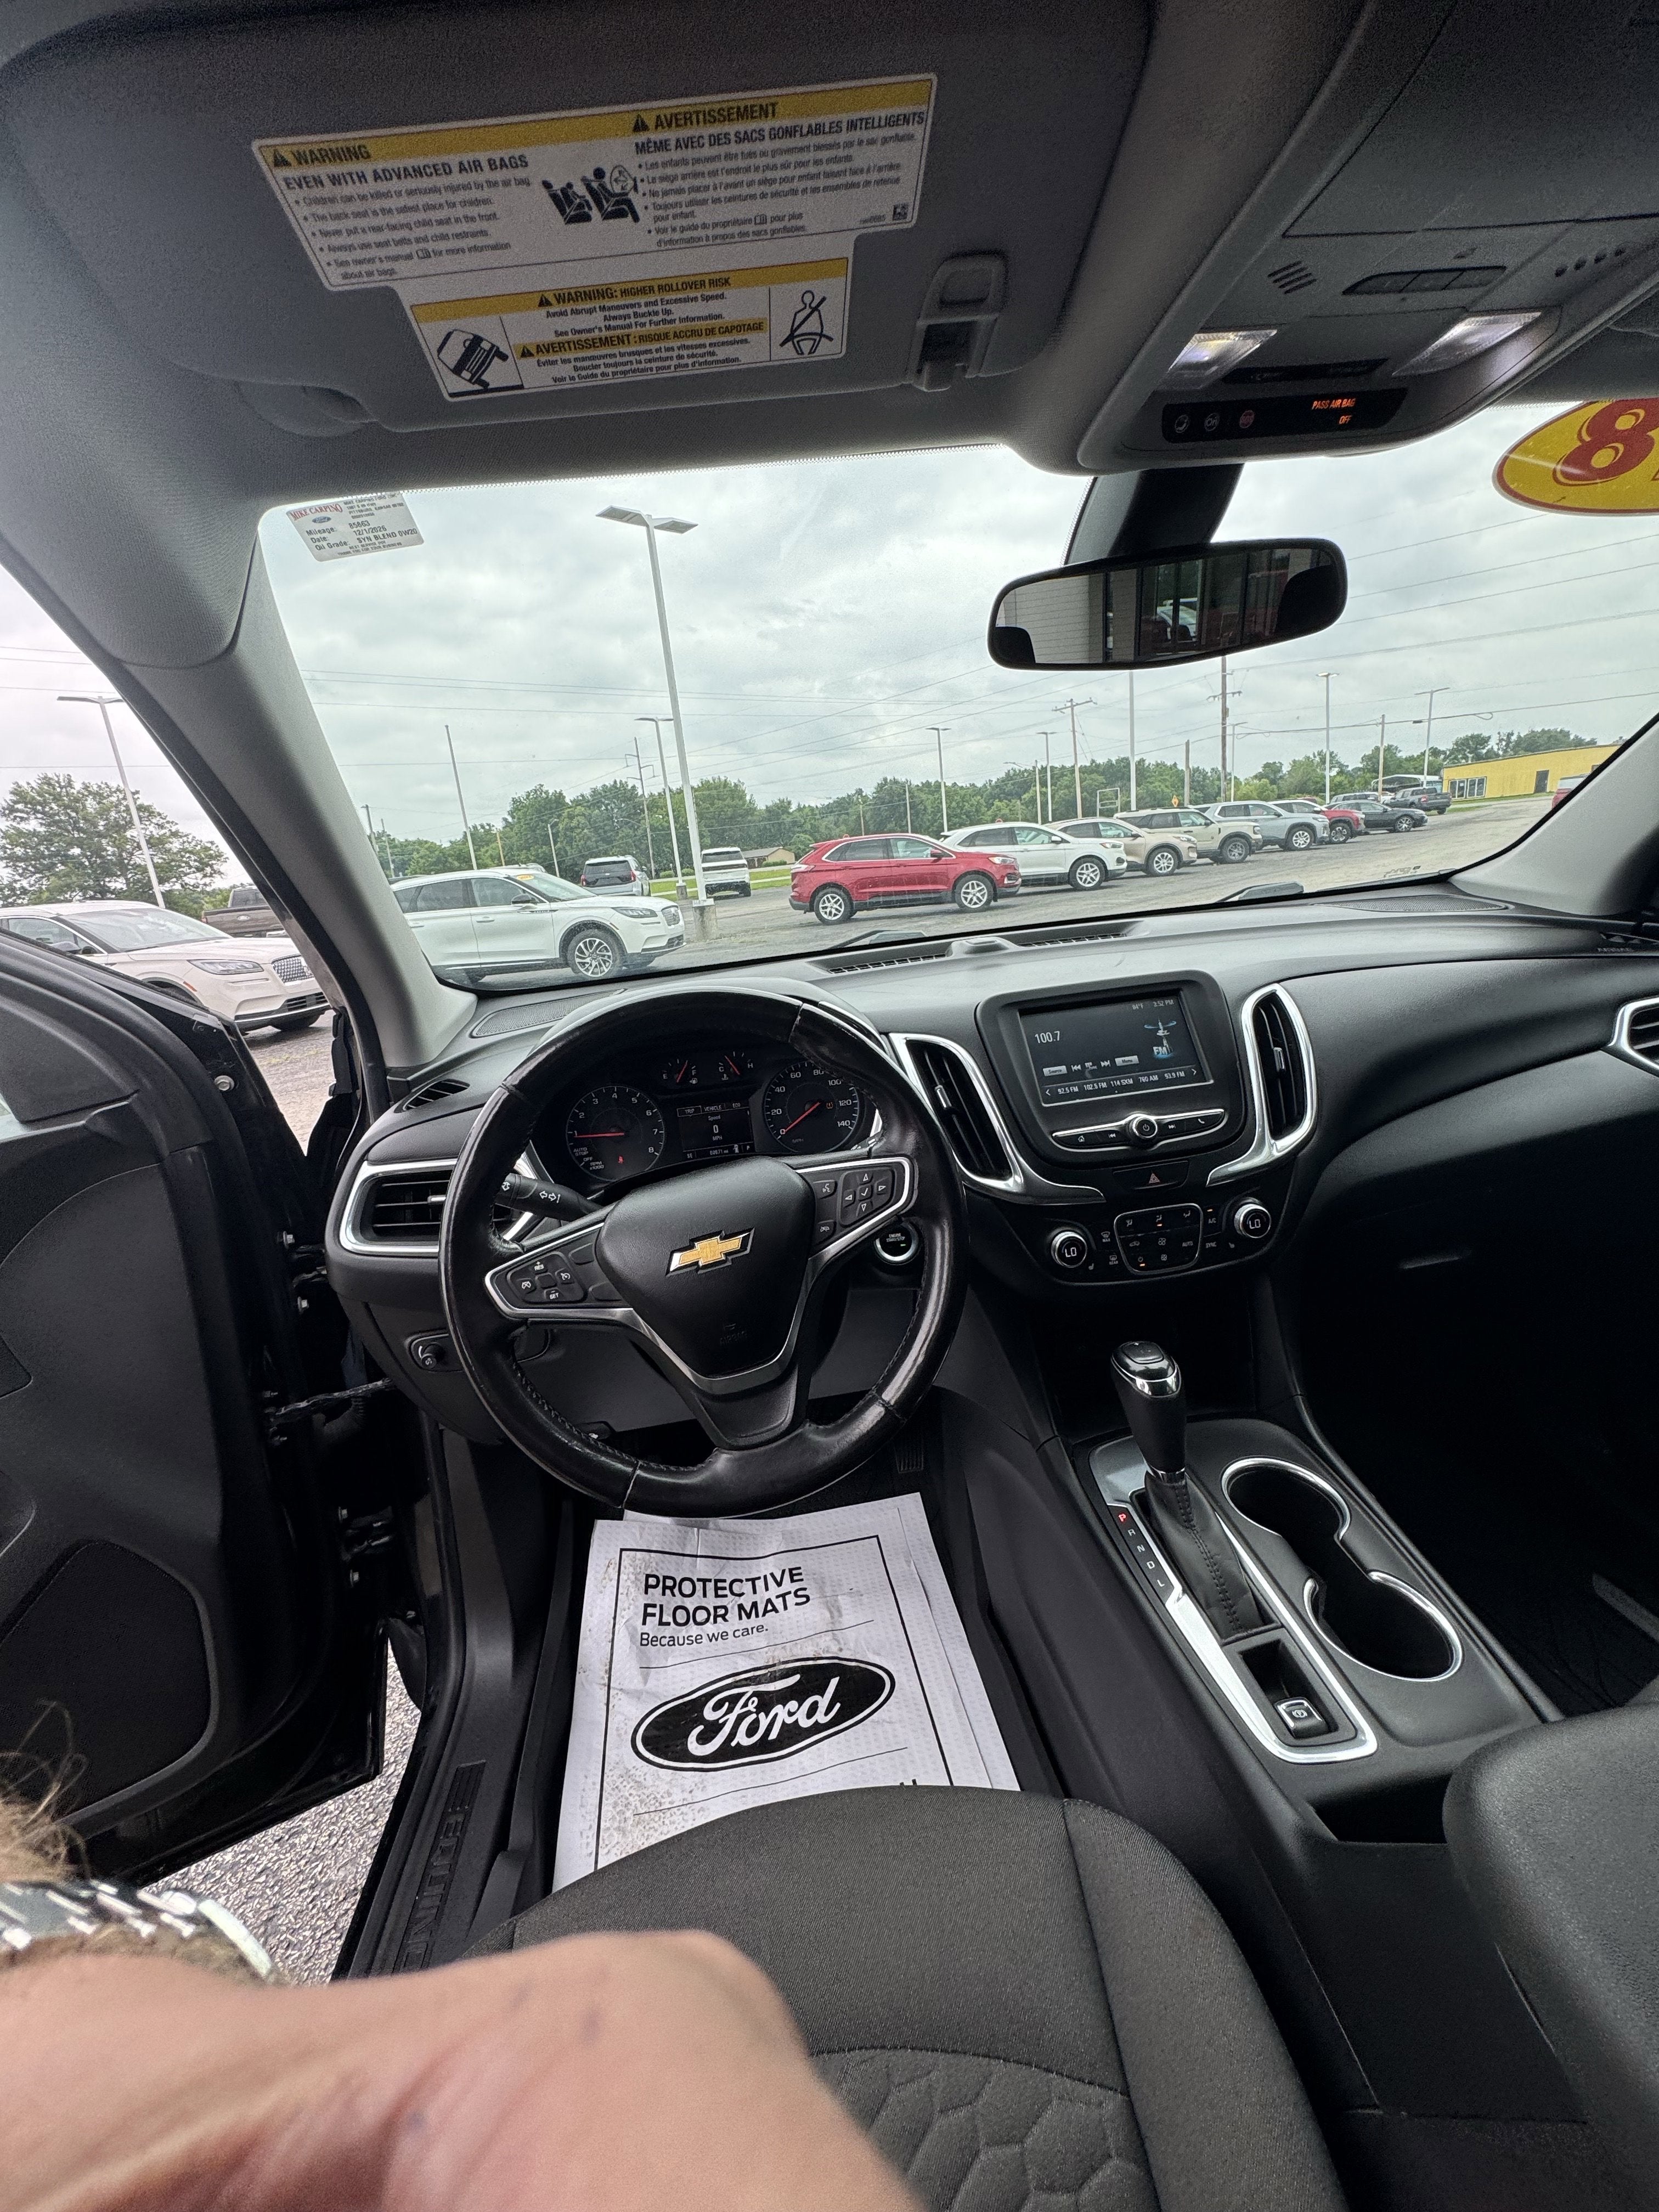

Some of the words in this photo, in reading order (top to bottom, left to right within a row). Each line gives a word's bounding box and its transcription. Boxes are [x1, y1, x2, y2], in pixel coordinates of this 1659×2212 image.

[655, 102, 778, 130] AVERTISSEMENT
[635, 138, 672, 154] MÊME
[675, 136, 704, 150] AVEC
[708, 132, 731, 146] DES
[735, 128, 765, 144] SACS
[769, 121, 843, 140] GONFLABLES
[847, 111, 924, 133] INTELLIGENTS
[292, 145, 371, 166] WARNING
[284, 175, 324, 189] EVEN
[327, 171, 368, 187] WITH
[373, 162, 452, 183] ADVANCED
[459, 159, 484, 174] AIR
[487, 154, 528, 171] BAGS
[554, 287, 617, 304] WARNING:
[620, 285, 655, 298] HIGHER
[658, 280, 706, 294] ROLLOVER
[709, 277, 731, 288] RISK
[546, 309, 568, 318] Avoid
[571, 306, 597, 315] Abrupt
[599, 301, 642, 312] Maneuvers
[644, 299, 658, 307] and
[661, 296, 698, 306] Excessive
[701, 292, 726, 303] Speed.
[604, 313, 631, 322] Always
[633, 309, 659, 319] Buckle
[662, 308, 674, 317] Up.
[571, 326, 602, 336] Owner's
[605, 322, 633, 332] Manual
[635, 320, 646, 329] For
[649, 318, 676, 328] Further
[679, 314, 725, 324] Information.
[536, 334, 631, 355] AVERTISSEMENT
[639, 331, 671, 343] RISQUE
[673, 328, 702, 339] ACCRU
[705, 327, 716, 336] DE
[719, 321, 763, 335] CAPOTAGE
[537, 358, 558, 367] Éviter
[619, 349, 652, 358] brusques
[677, 342, 707, 352] vitesses
[709, 338, 750, 348] excessives.
[573, 363, 601, 372] Boucler
[603, 360, 633, 369] toujours
[644, 354, 674, 364] ceinture
[686, 350, 718, 360] sécurité.
[552, 375, 567, 383] Voir
[578, 372, 598, 381] Guide
[612, 366, 653, 377] propriétaire
[655, 365, 672, 373] pour
[674, 362, 689, 370] plus
[1312, 399, 1330, 410] PASS
[1330, 399, 1341, 409] AIR
[1342, 398, 1356, 408] BAG
[1339, 415, 1352, 425] OFF
[290, 509, 309, 521] MIKE
[309, 503, 343, 517] CARPINO
[306, 526, 336, 536] Mileage:
[349, 520, 370, 529] 85863
[311, 535, 328, 544] Date:
[353, 525, 387, 536] 12/1/2026
[315, 542, 325, 551] Oil
[327, 540, 349, 549] Grade:
[357, 535, 371, 544] SYN
[375, 532, 397, 541] BLEND
[1035, 1031, 1060, 1044] 100.7
[1153, 1046, 1168, 1056] FM
[713, 1125, 719, 1133] 0
[1118, 1513, 1127, 1522] P
[1127, 1528, 1136, 1536] R
[1137, 1544, 1145, 1553] N
[1146, 1561, 1156, 1571] D
[643, 1566, 805, 1599] PROTECTIVE
[1156, 1579, 1165, 1588] L
[641, 1603, 729, 1627] FLOOR
[737, 1587, 811, 1622] MATS
[639, 1630, 704, 1648] Because
[707, 1632, 730, 1643] we
[732, 1625, 769, 1640] care.
[687, 1673, 841, 1757] Ford
